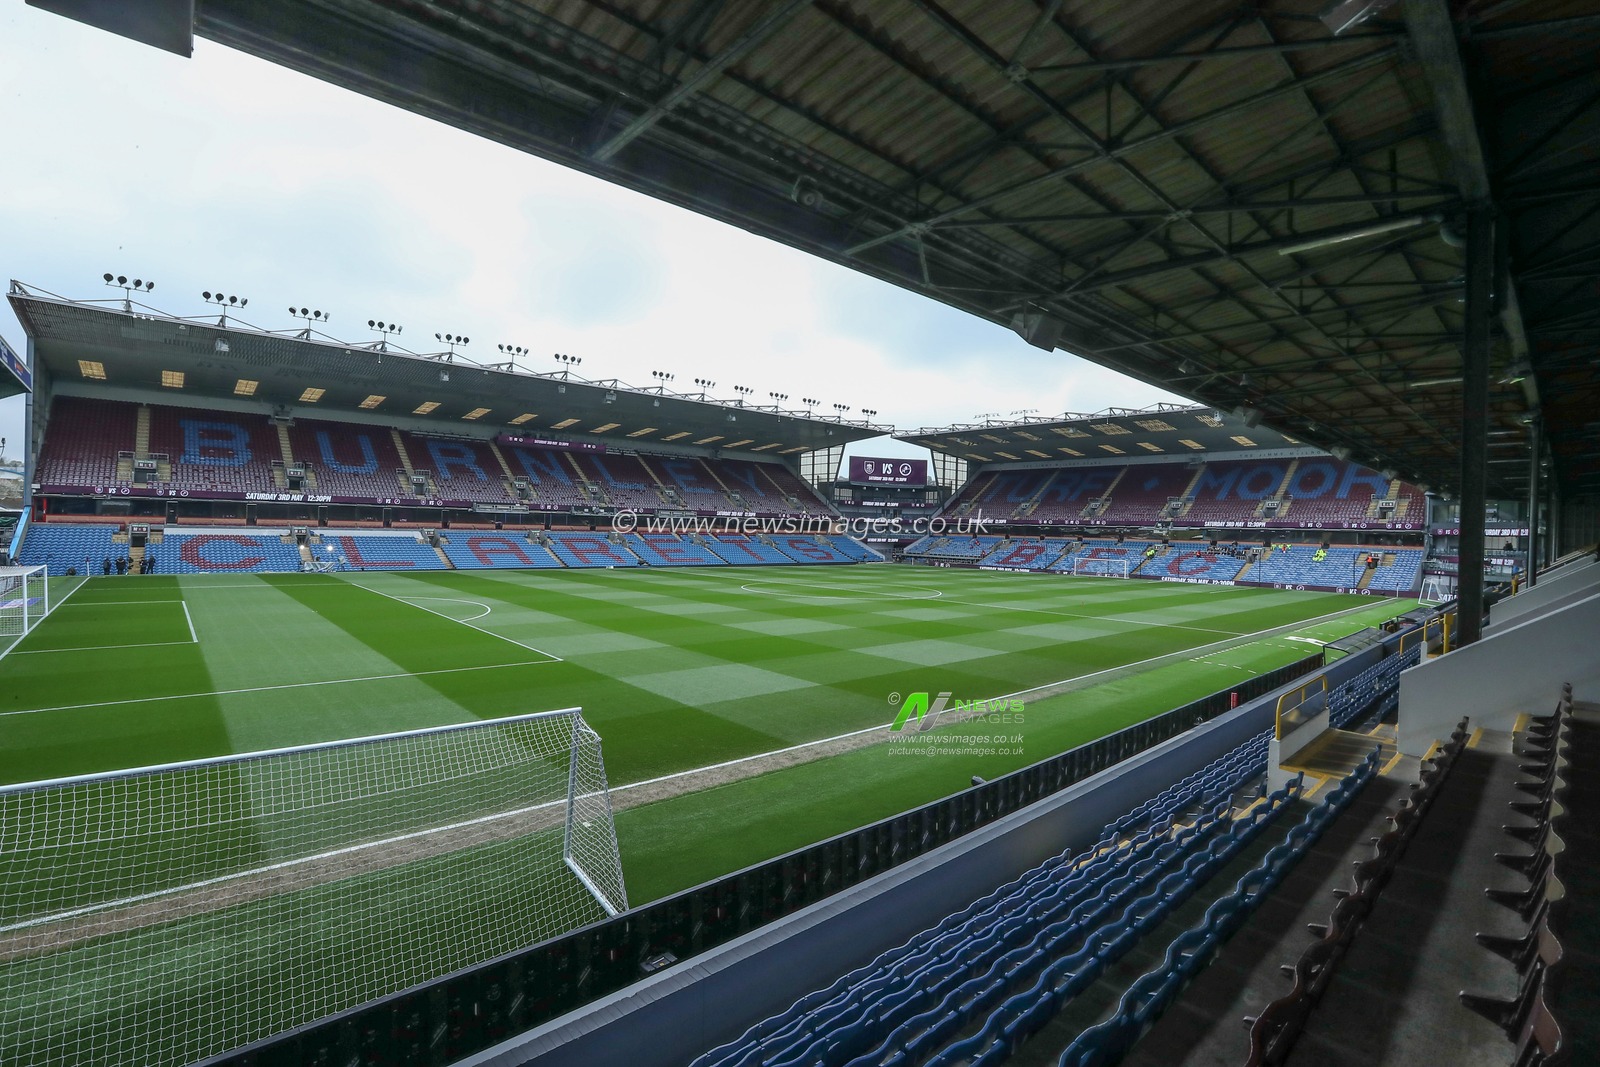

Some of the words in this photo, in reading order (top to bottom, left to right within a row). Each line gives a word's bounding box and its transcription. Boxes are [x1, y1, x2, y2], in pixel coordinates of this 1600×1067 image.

[179, 418, 765, 497] BURNLEY
[882, 463, 893, 474] VS
[245, 492, 278, 501] SATURDAY
[277, 493, 290, 501] 3RD
[181, 534, 835, 569] CLARETS
